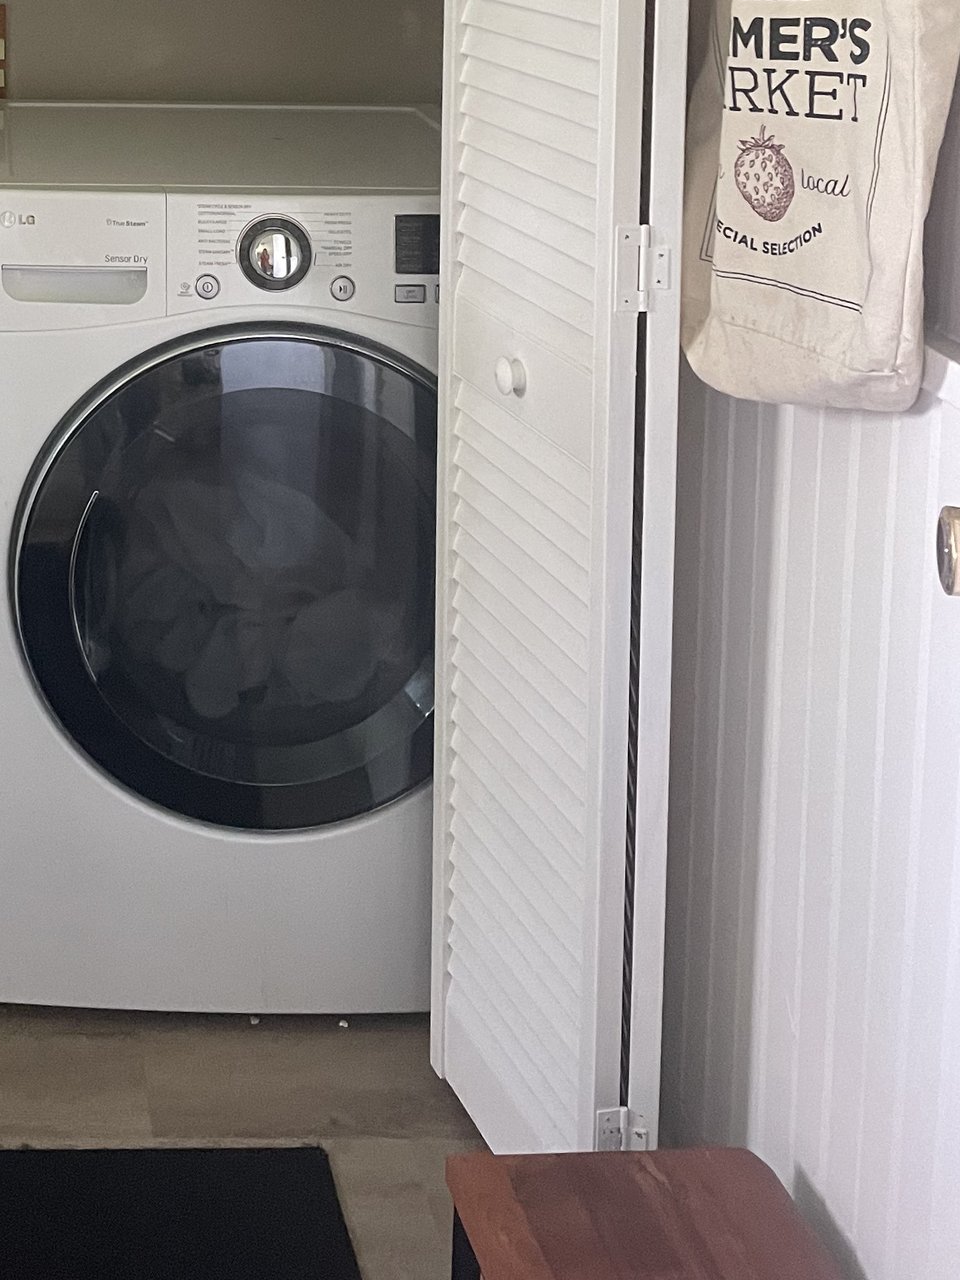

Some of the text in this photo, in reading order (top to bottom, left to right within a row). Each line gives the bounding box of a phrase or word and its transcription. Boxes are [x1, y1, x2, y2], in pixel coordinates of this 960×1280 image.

[729, 16, 872, 65] MER'S
[723, 66, 868, 123] RKET
[801, 167, 852, 198] local
[18, 215, 36, 225] LG
[715, 220, 824, 256] ECIAL SELECTION
[104, 254, 148, 265] Sensor Dry
